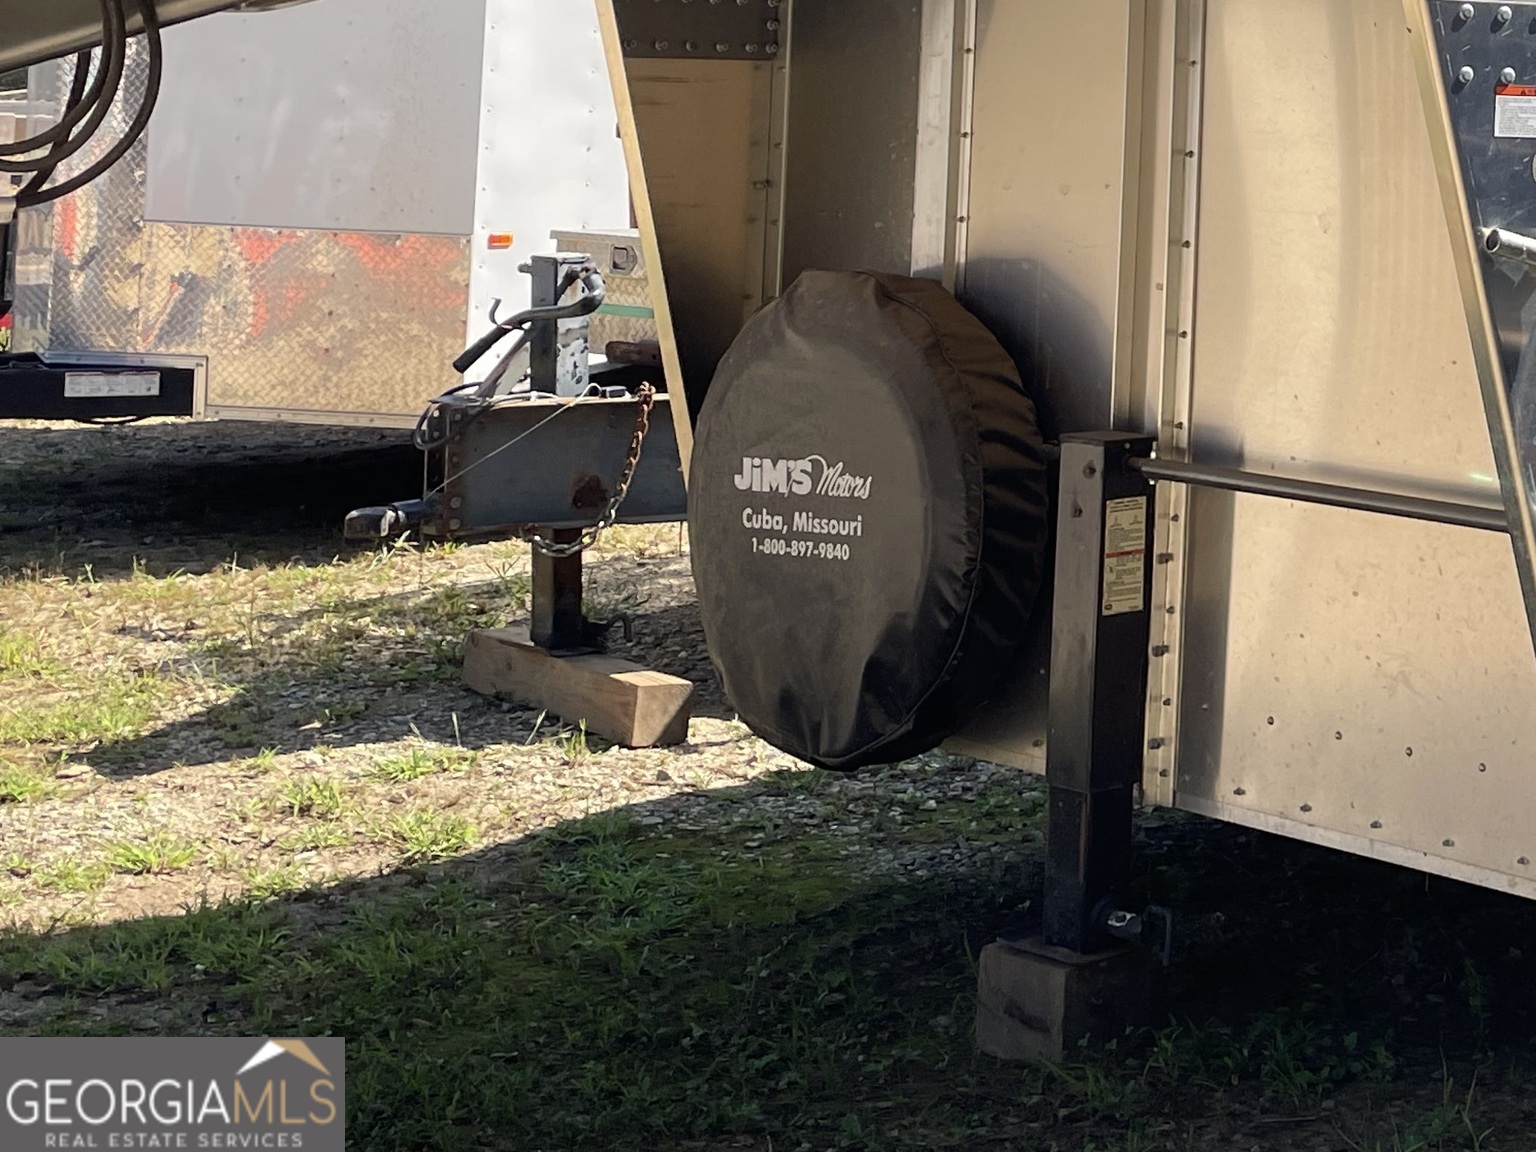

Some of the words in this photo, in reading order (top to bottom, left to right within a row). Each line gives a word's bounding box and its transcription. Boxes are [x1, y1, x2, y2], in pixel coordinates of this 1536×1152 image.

[812, 455, 873, 499] Motors
[742, 507, 788, 534] Cuba,
[793, 511, 862, 537] Missouri
[752, 537, 850, 561] 1-800-897-9840
